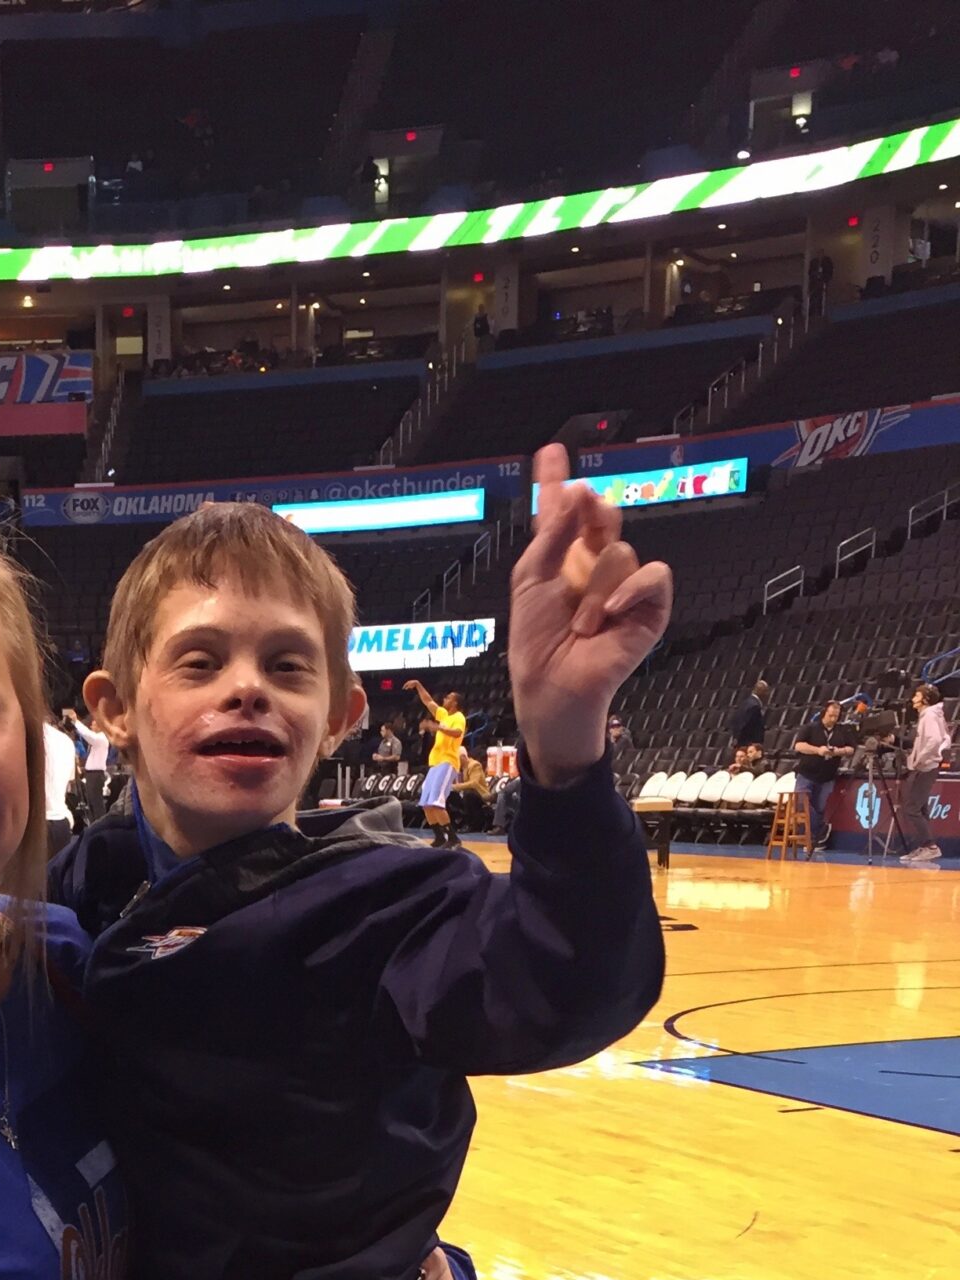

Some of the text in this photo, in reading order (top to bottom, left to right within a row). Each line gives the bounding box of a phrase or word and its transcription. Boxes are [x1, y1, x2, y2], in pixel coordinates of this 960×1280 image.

[796, 410, 864, 467] OKC
[498, 462, 520, 477] 112
[579, 453, 604, 468] 113
[324, 472, 485, 500] @okcthunder
[23, 494, 46, 508] 112
[72, 498, 101, 512] FOX
[347, 623, 487, 654] OMELAND
[927, 795, 951, 819] The
